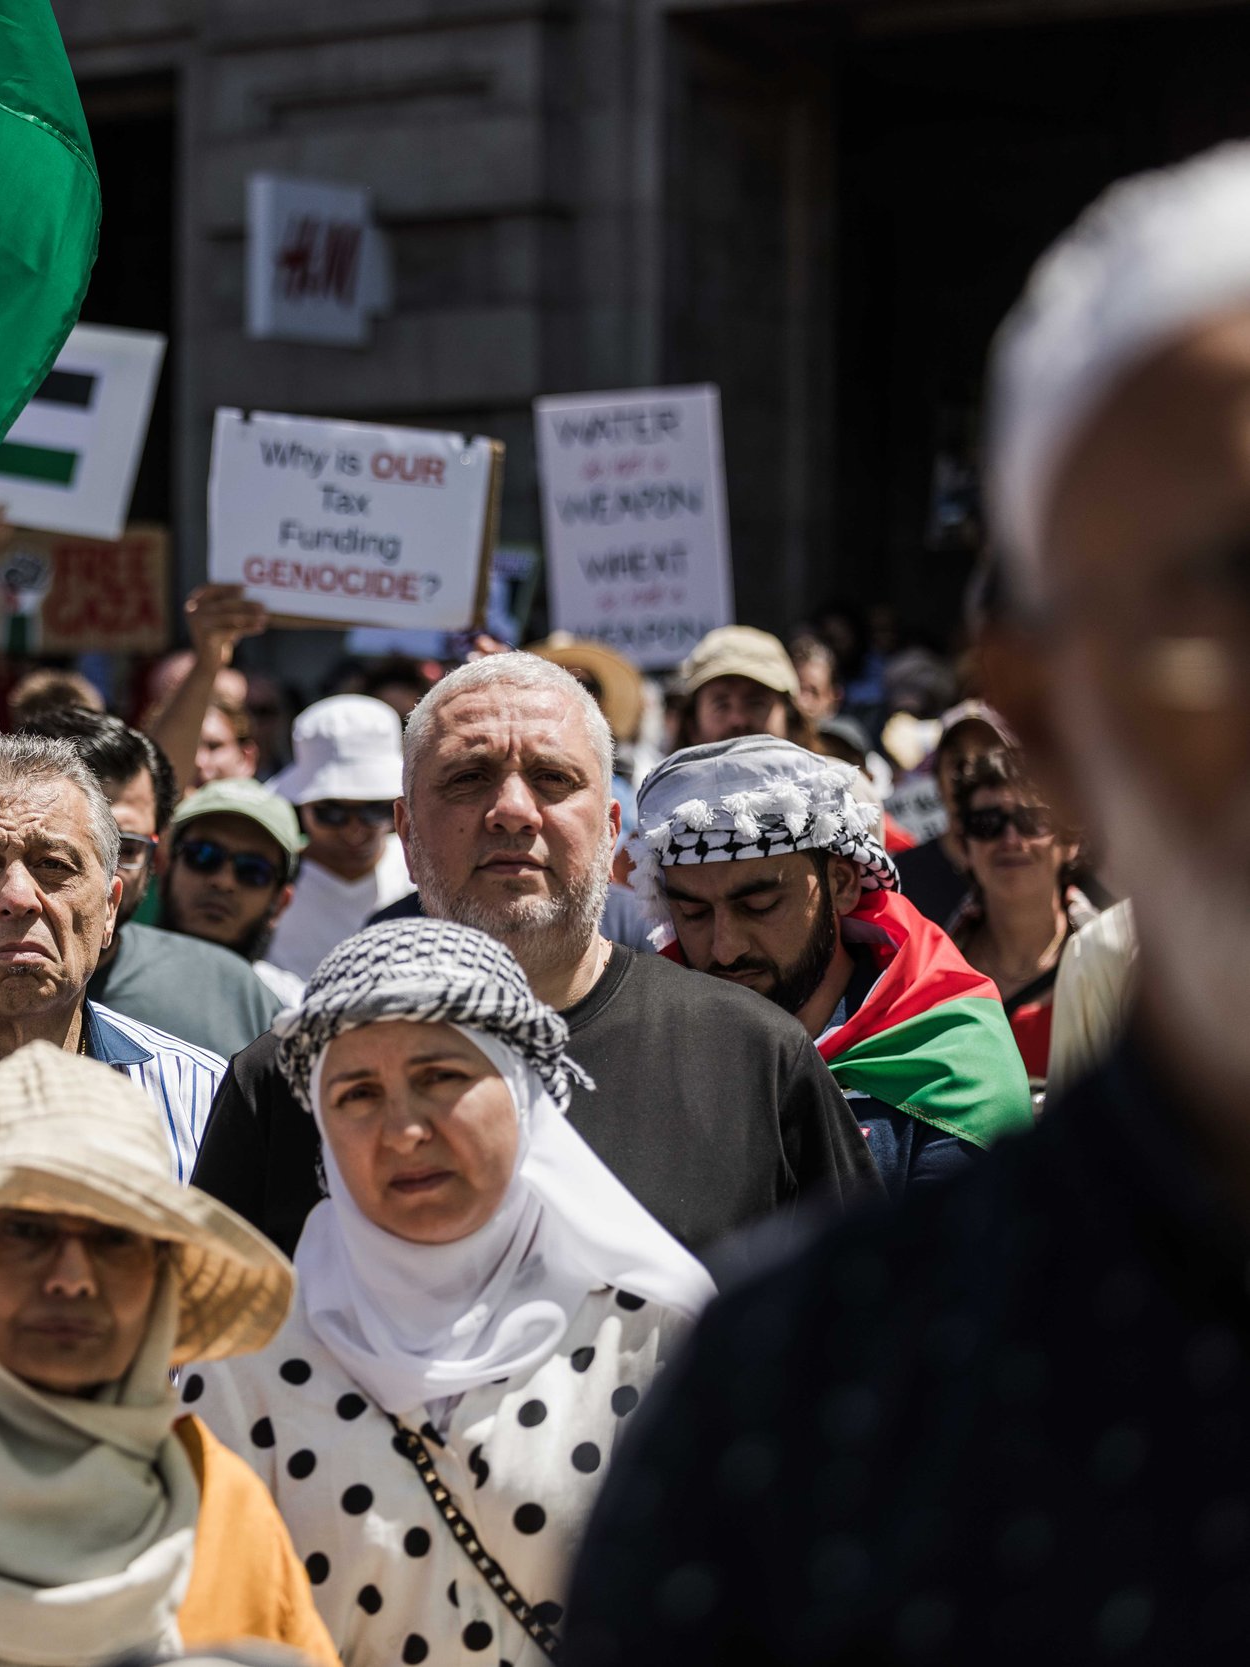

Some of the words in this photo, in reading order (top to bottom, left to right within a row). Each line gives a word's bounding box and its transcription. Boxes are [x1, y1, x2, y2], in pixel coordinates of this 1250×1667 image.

[259, 438, 330, 479] Why
[335, 449, 362, 477] is
[370, 450, 446, 486] OUR
[320, 482, 371, 516] Tax
[278, 518, 402, 565] Funding
[243, 557, 441, 601] GENOCIDE?
